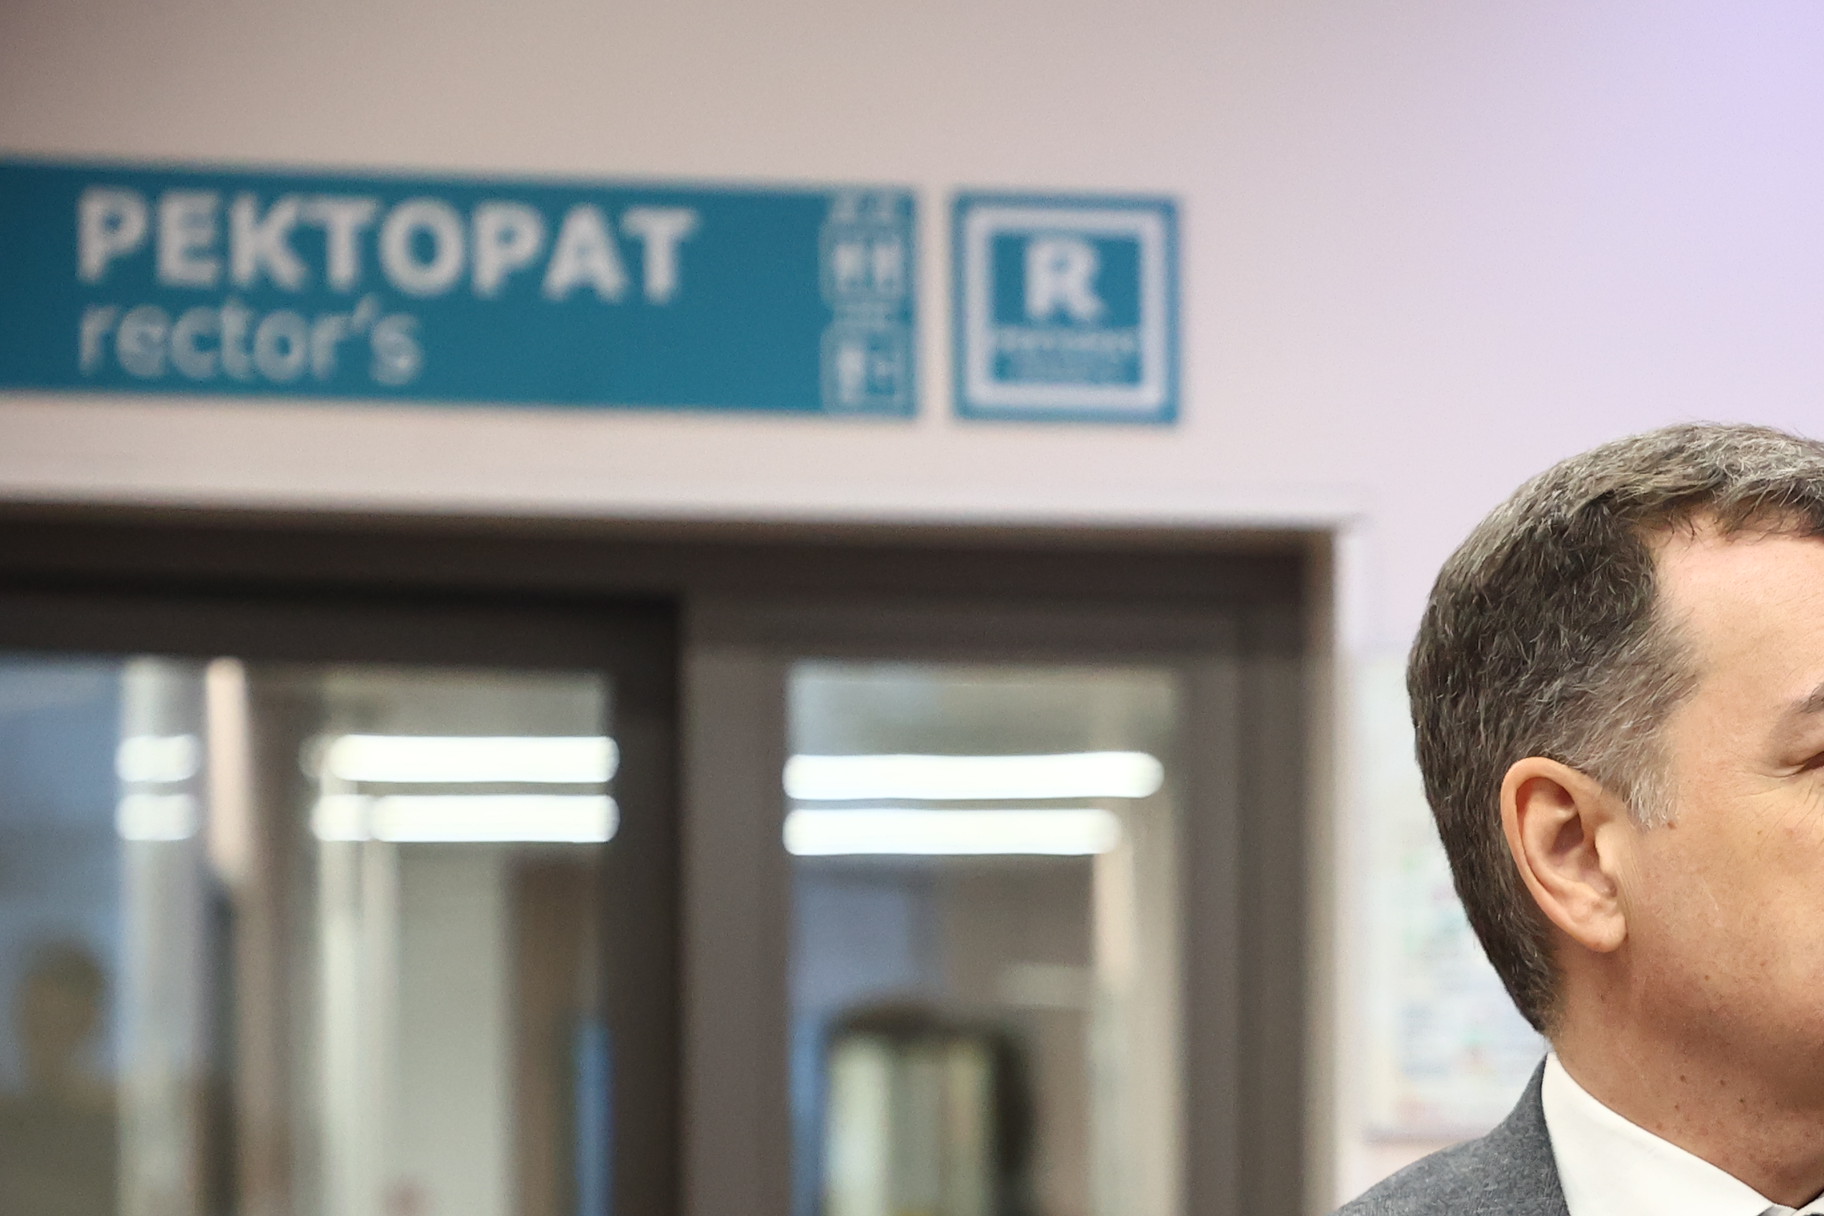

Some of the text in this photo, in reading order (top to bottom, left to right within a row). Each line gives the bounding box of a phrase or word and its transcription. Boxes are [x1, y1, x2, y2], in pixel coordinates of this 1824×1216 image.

[77, 187, 697, 301] РЕКТОРАТ
[1024, 238, 1104, 324] R
[79, 300, 421, 384] rector's
